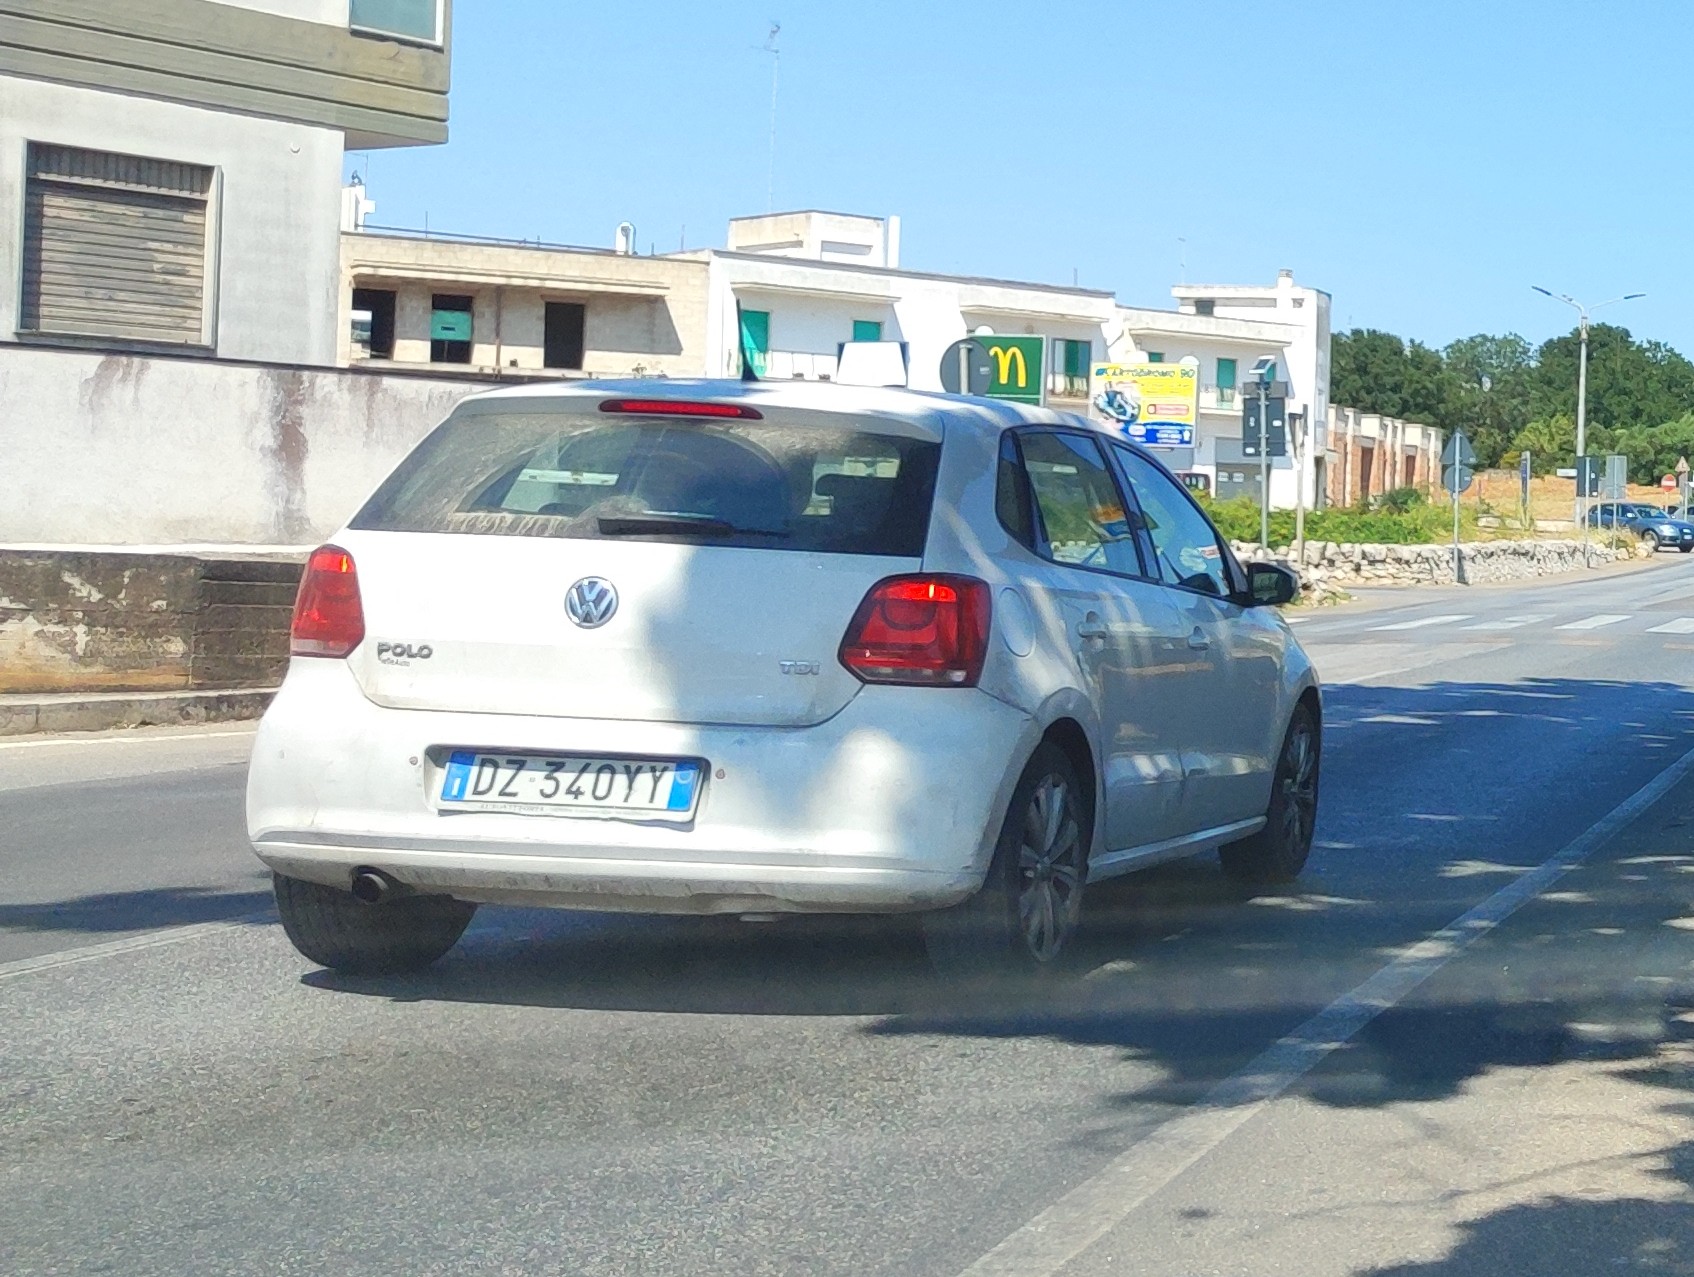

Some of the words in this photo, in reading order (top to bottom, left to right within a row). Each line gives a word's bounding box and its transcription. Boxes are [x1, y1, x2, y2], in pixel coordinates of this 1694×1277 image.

[377, 641, 434, 660] POLO
[779, 659, 821, 676] TDI
[472, 757, 528, 797] DZ
[539, 761, 670, 804] 340YY
